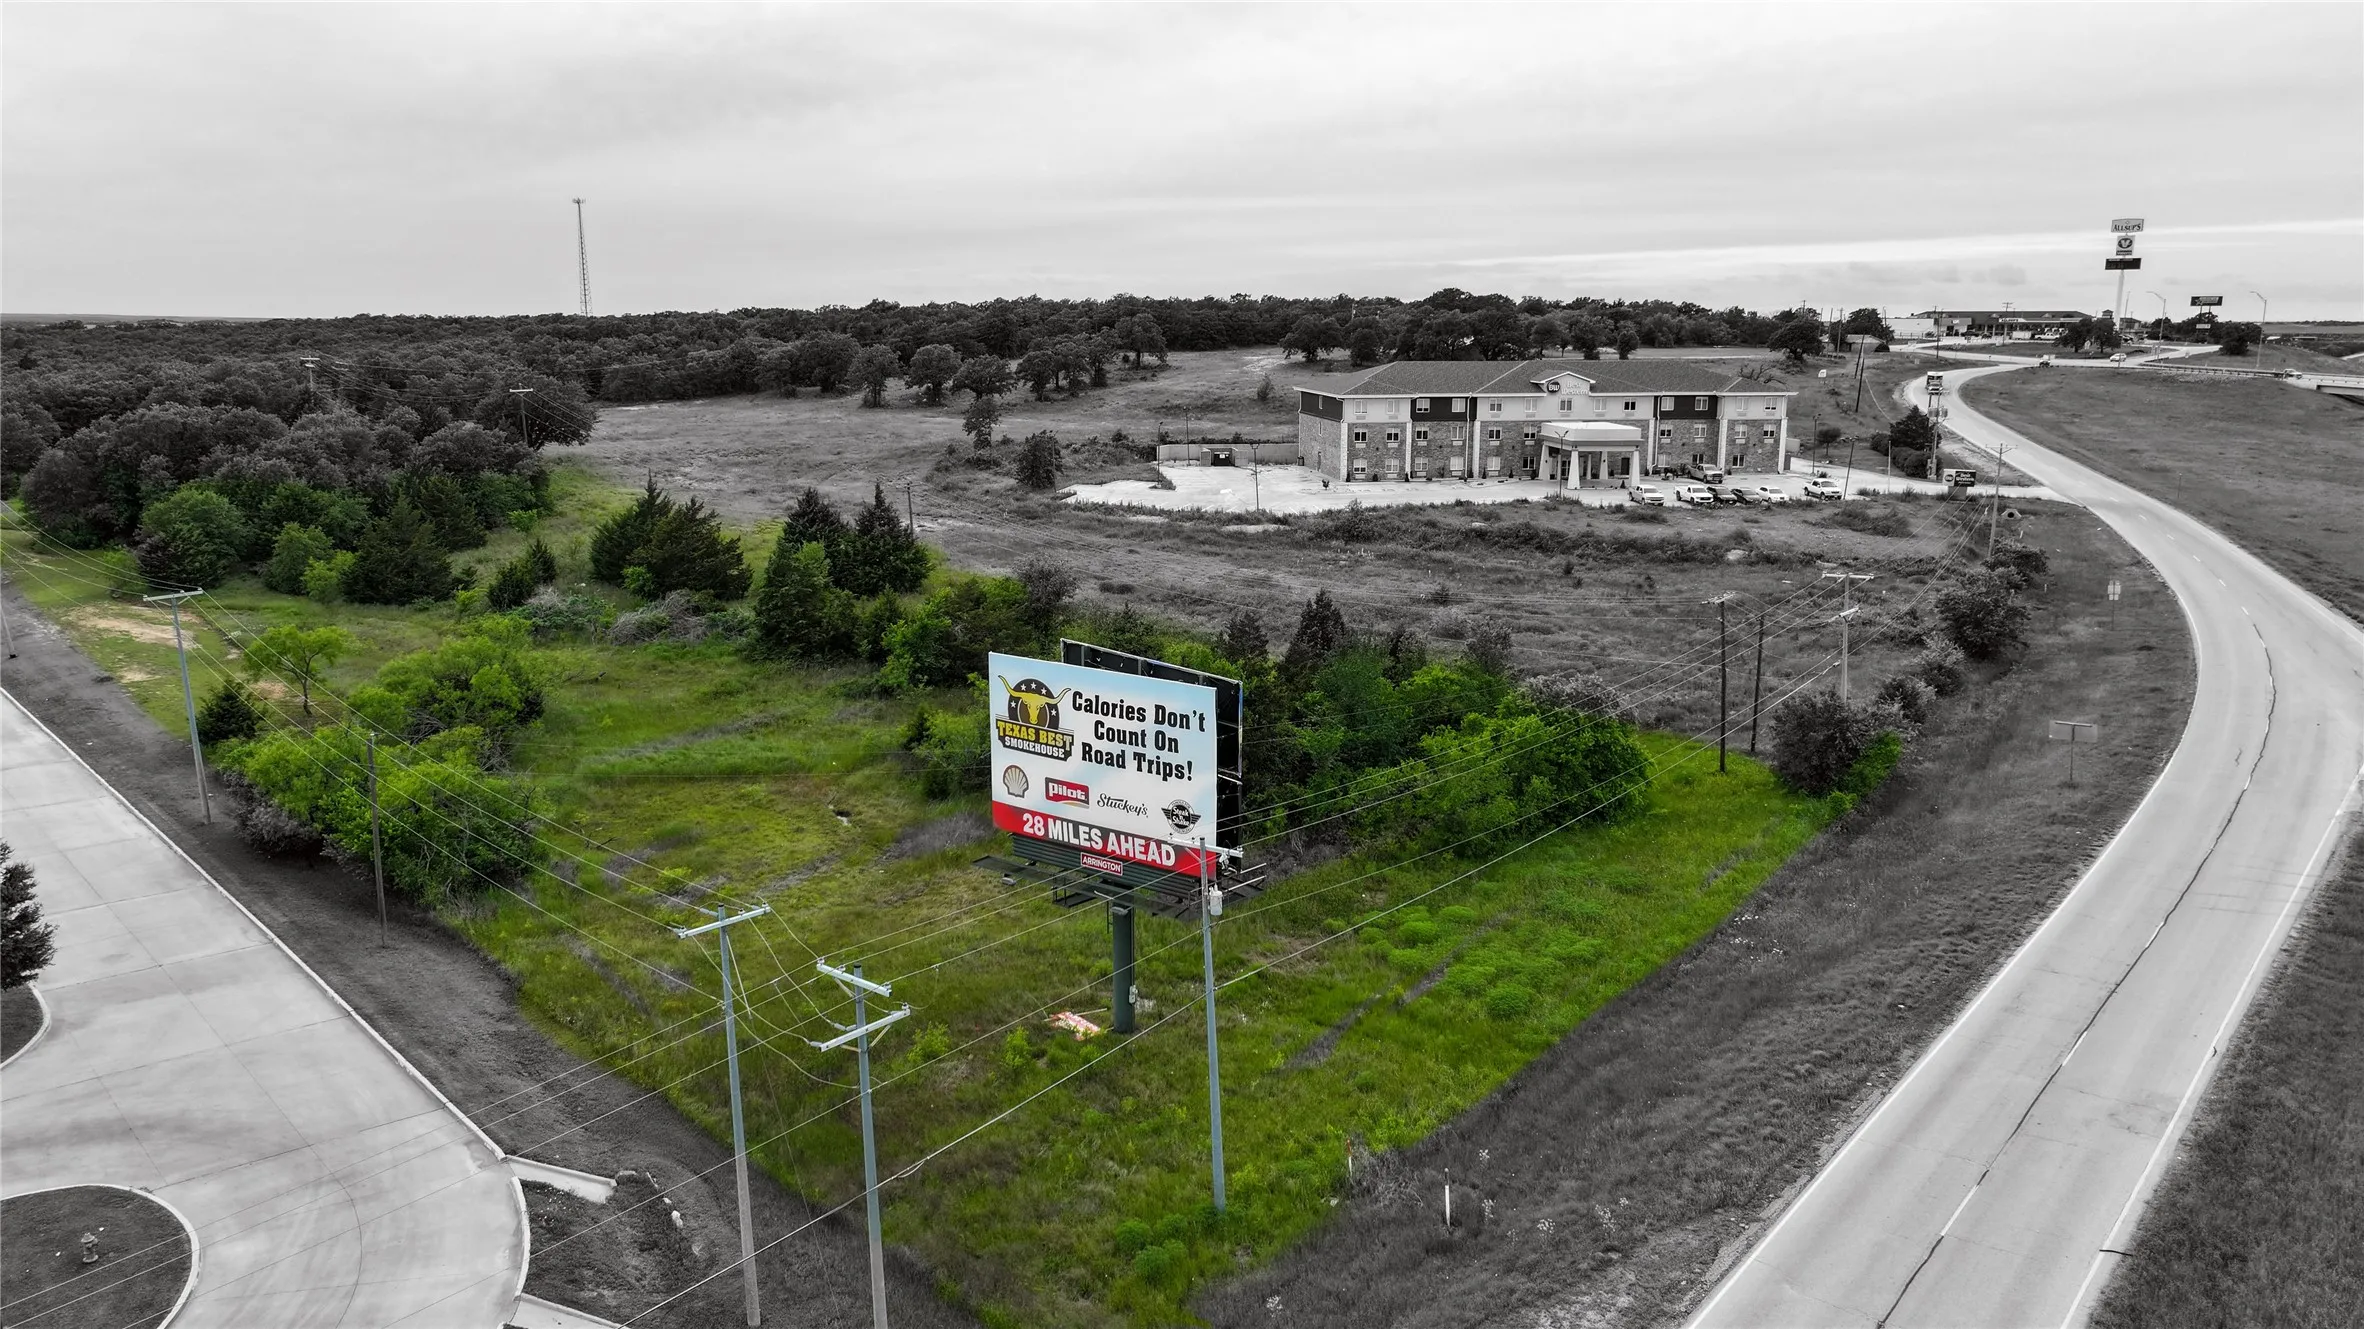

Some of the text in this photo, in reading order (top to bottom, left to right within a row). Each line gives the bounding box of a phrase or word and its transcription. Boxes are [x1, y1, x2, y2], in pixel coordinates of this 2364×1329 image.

[1072, 691, 1205, 732] Calories Don't
[997, 721, 1072, 751] TEXAS BEST
[1004, 736, 1065, 758] SMOKEHOUSE
[1094, 720, 1179, 753] Count On
[1081, 741, 1193, 782] Road Trips!
[1097, 793, 1148, 816] Stuckey's
[1022, 813, 1176, 867] 28 MILES AHEAD
[1082, 856, 1121, 872] ARRINGTON
